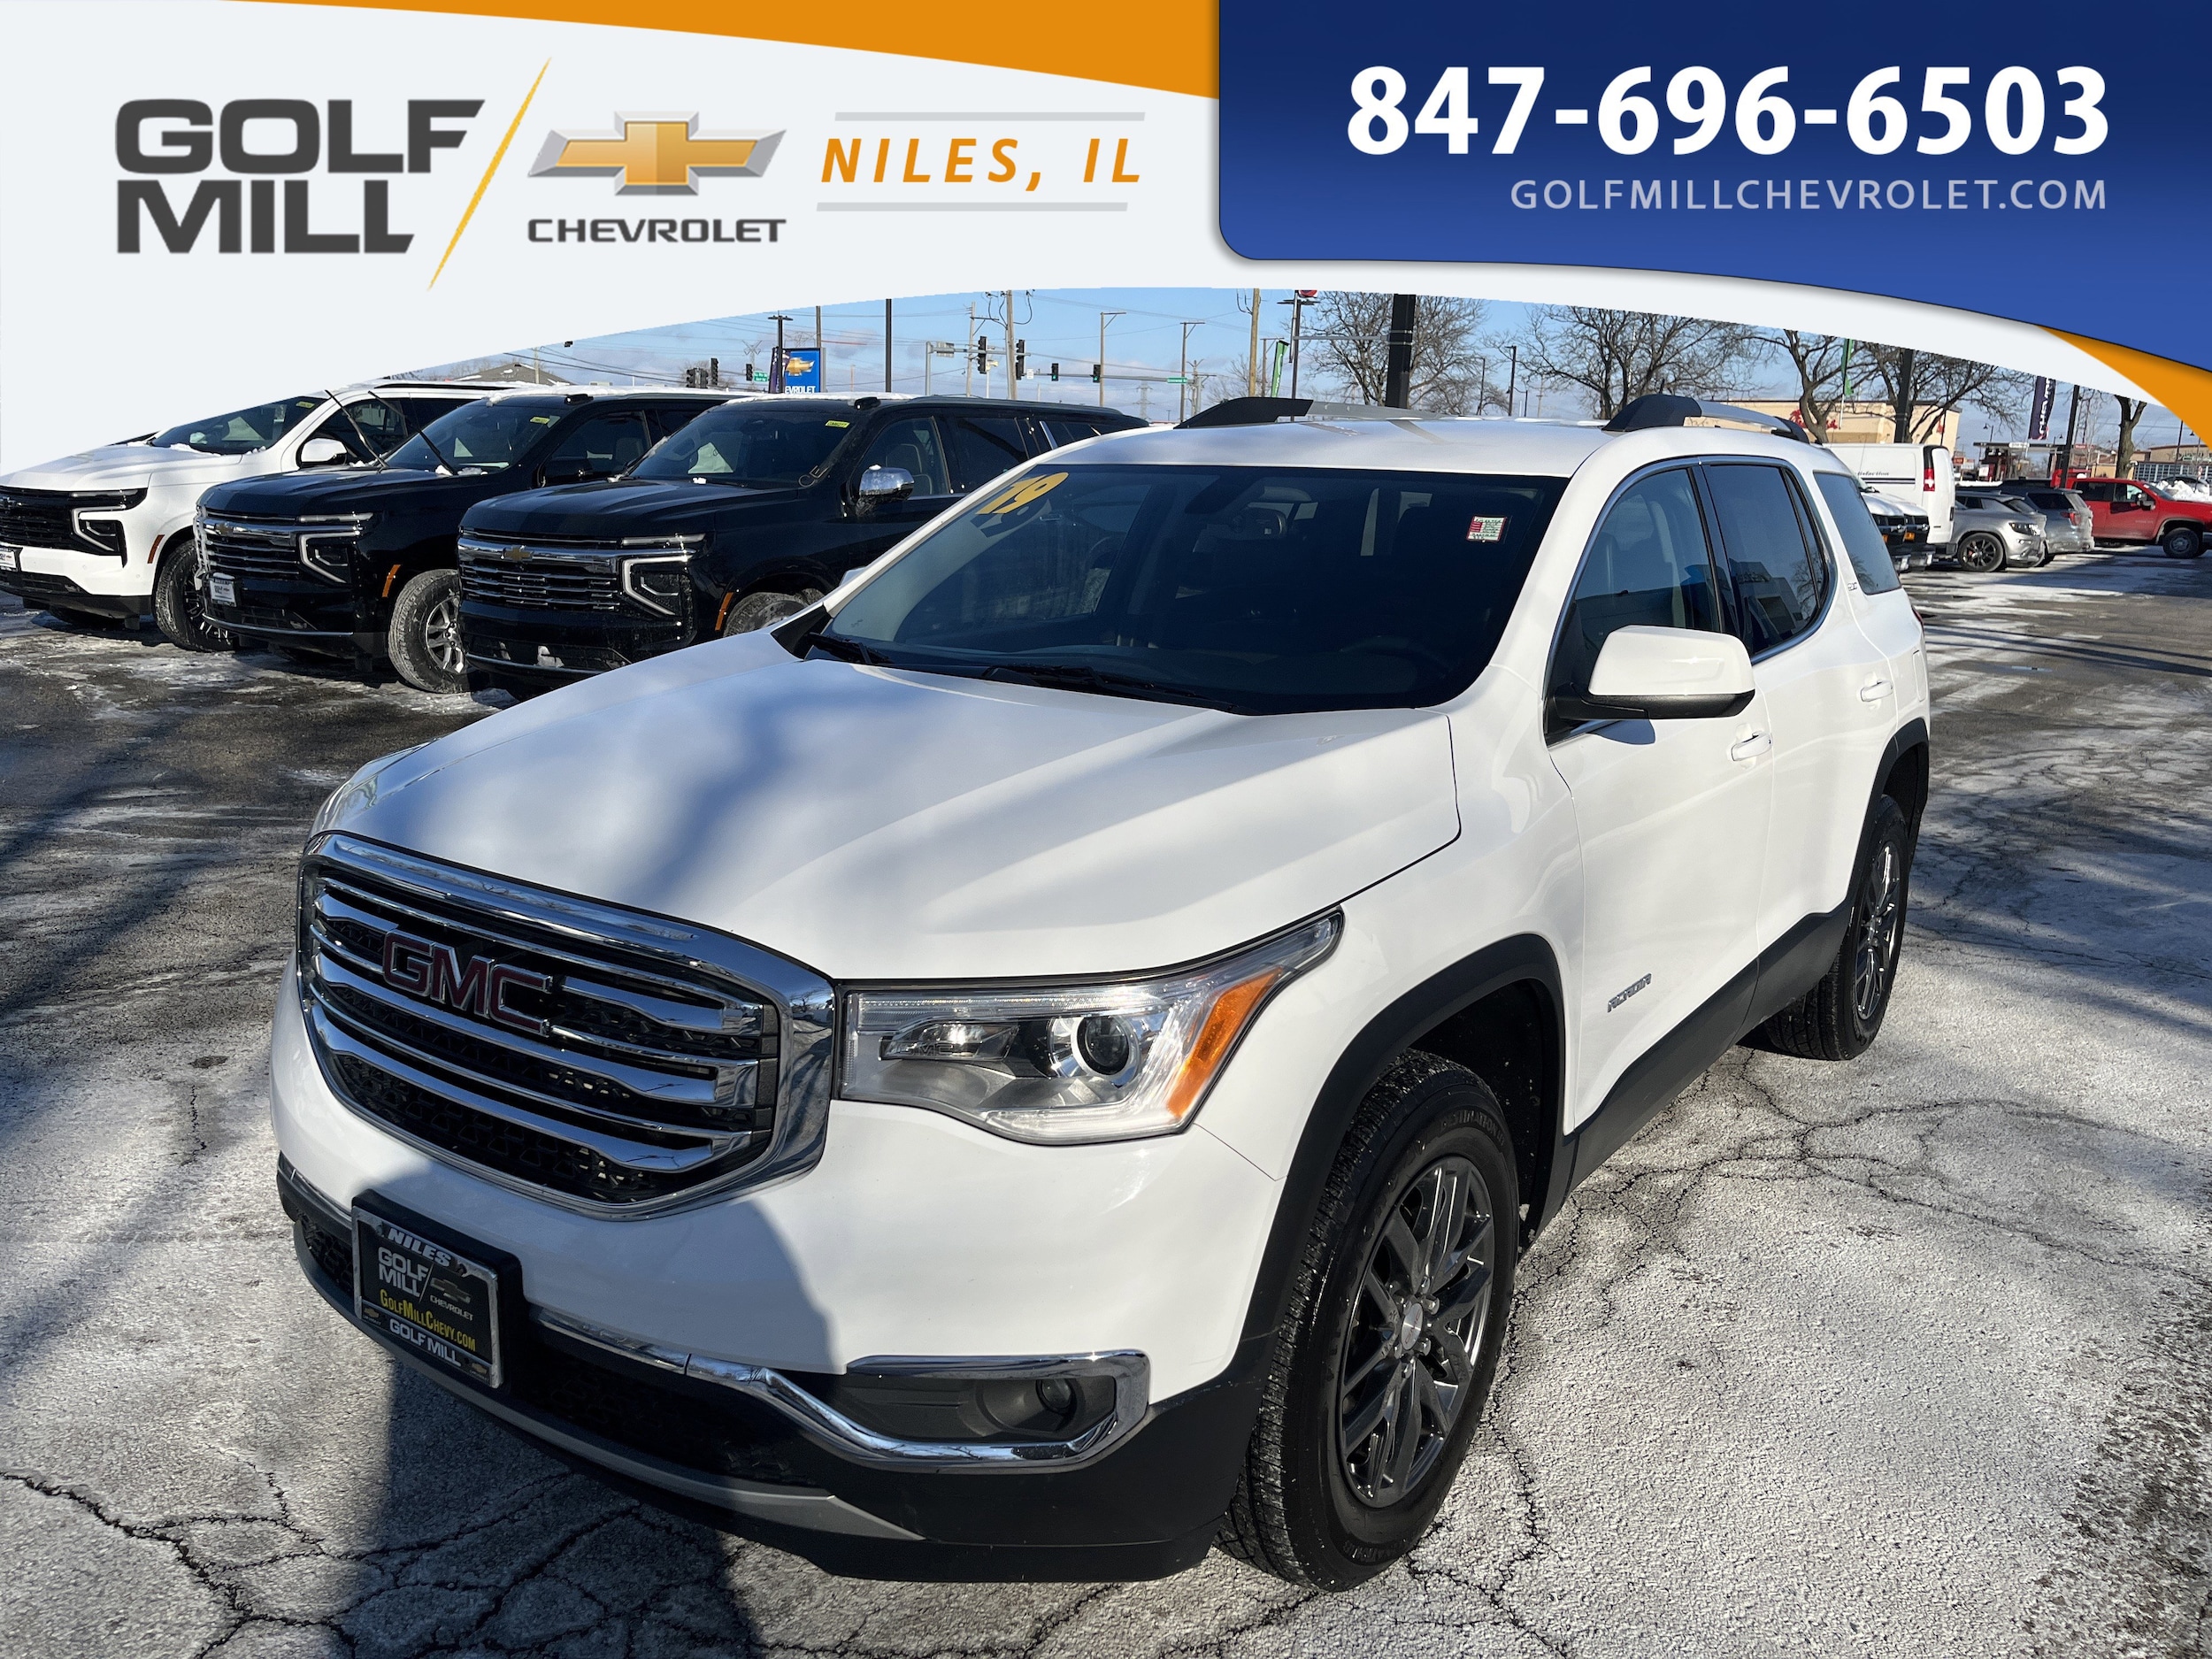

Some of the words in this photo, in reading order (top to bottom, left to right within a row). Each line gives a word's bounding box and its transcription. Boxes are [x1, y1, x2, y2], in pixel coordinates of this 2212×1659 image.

[382, 928, 553, 1038] GMC
[378, 1246, 429, 1282] GOLF
[388, 1227, 451, 1268] NILES
[379, 1263, 420, 1298] MILL
[429, 1294, 474, 1322] CHEVROLET
[389, 1317, 426, 1348] GOLF
[427, 1336, 461, 1367] MILL
